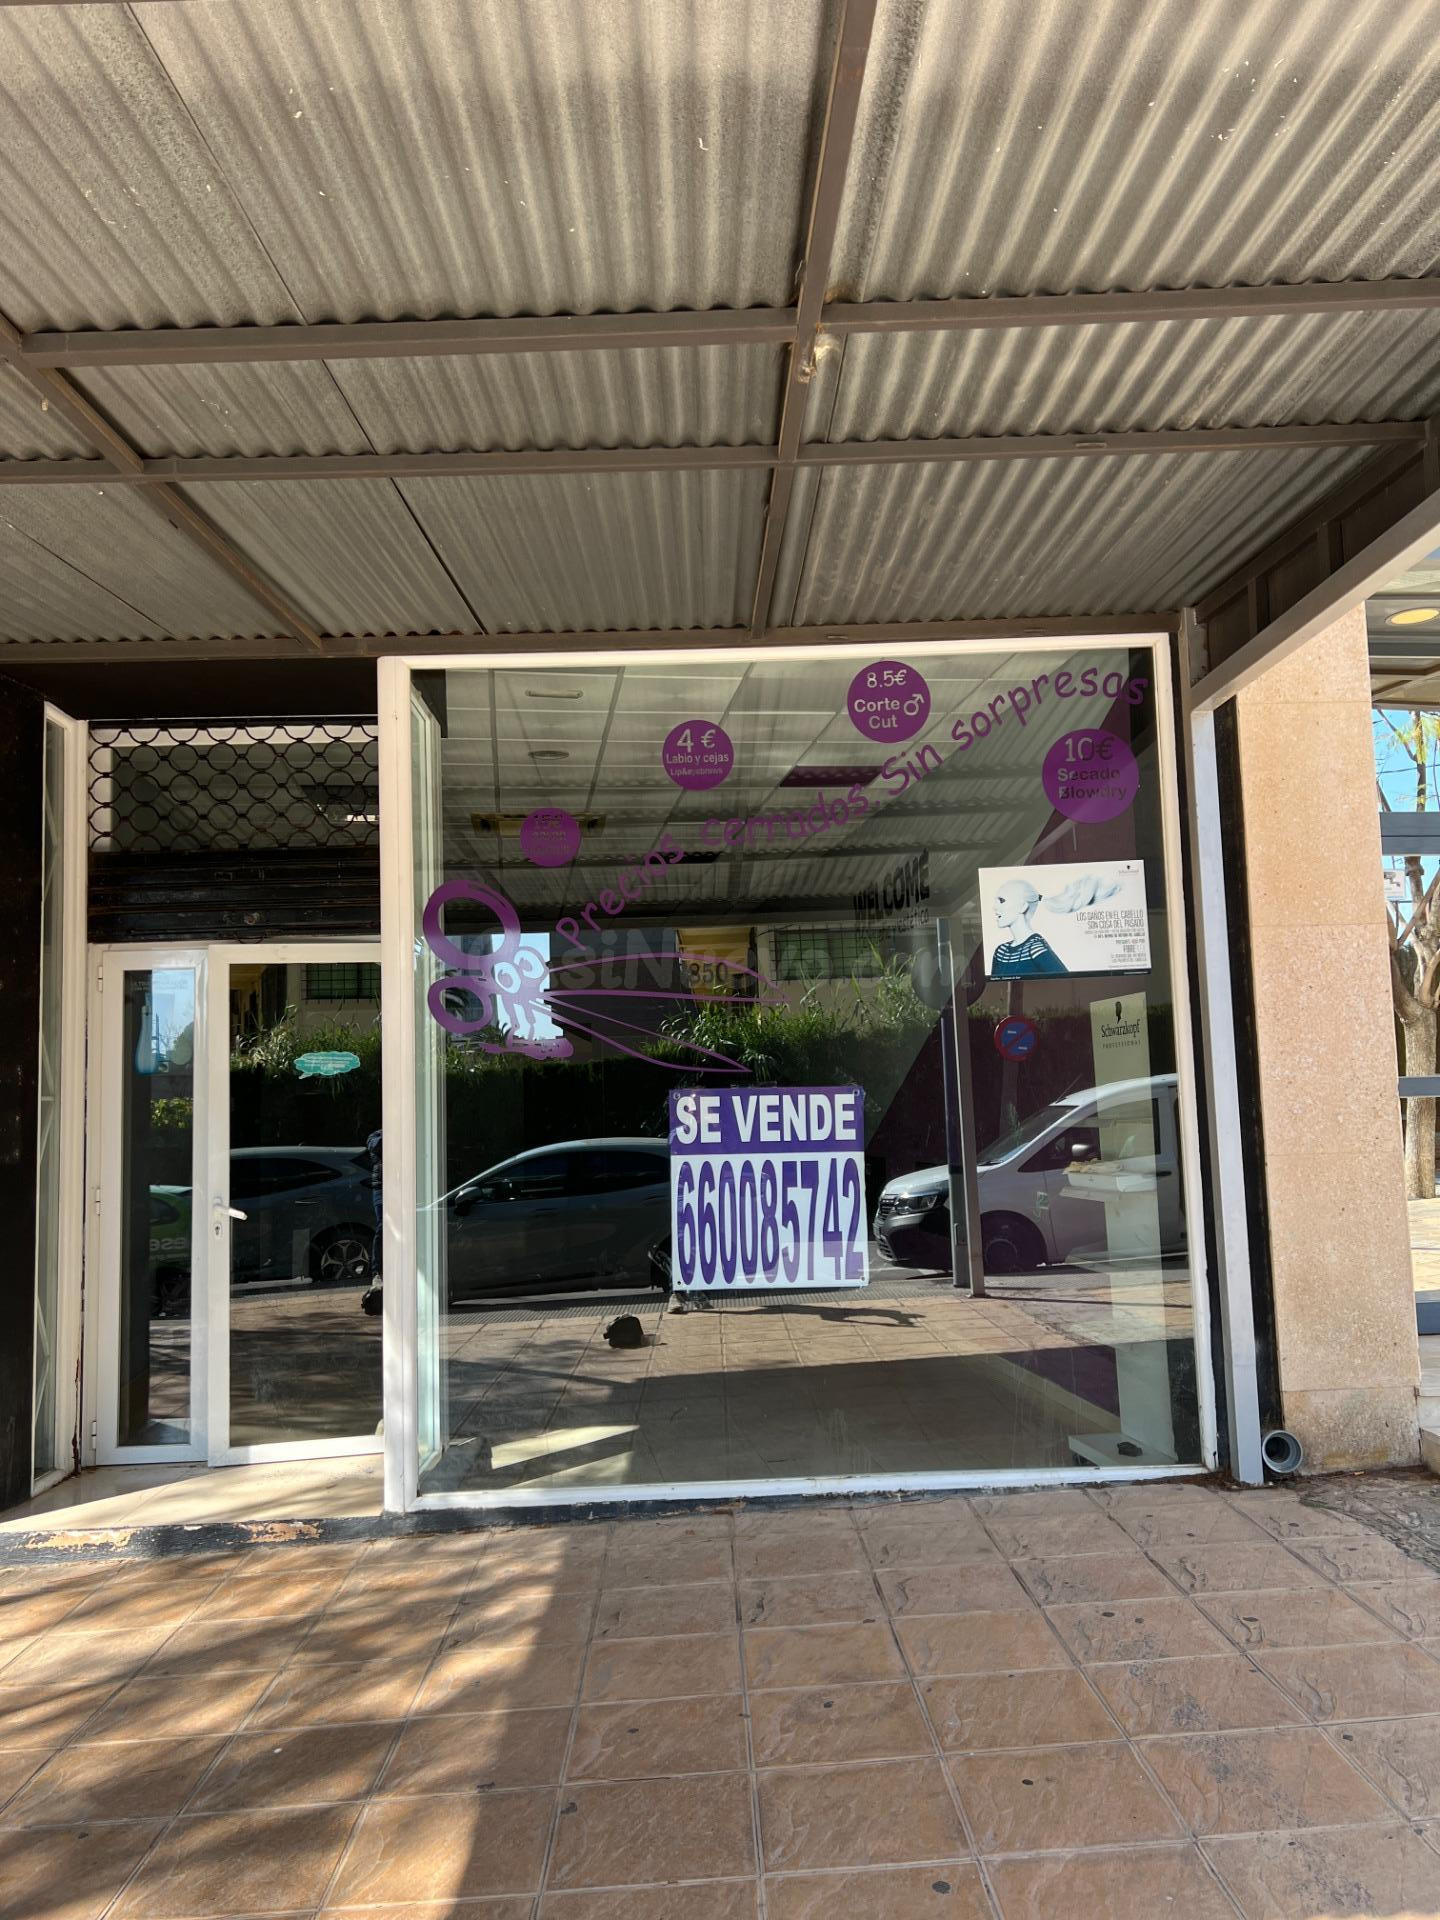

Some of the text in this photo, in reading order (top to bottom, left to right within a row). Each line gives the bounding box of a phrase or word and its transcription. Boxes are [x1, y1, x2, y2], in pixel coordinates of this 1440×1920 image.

[867, 669, 907, 688] 8.5€
[854, 697, 900, 713] Corte
[869, 714, 898, 729] Cut
[676, 728, 716, 753] 4 €
[1064, 736, 1115, 761] 10€
[666, 752, 729, 766] Labio y cejas
[1057, 767, 1120, 781] Secado
[1058, 784, 1127, 801] Blowdry
[556, 832, 685, 950] Precios
[881, 744, 944, 796] Sin
[951, 667, 1149, 750] sorpresas
[1101, 1019, 1140, 1038] Schwarzkopf
[675, 1093, 857, 1145] SE VENDE
[677, 1157, 864, 1285] 660085742
